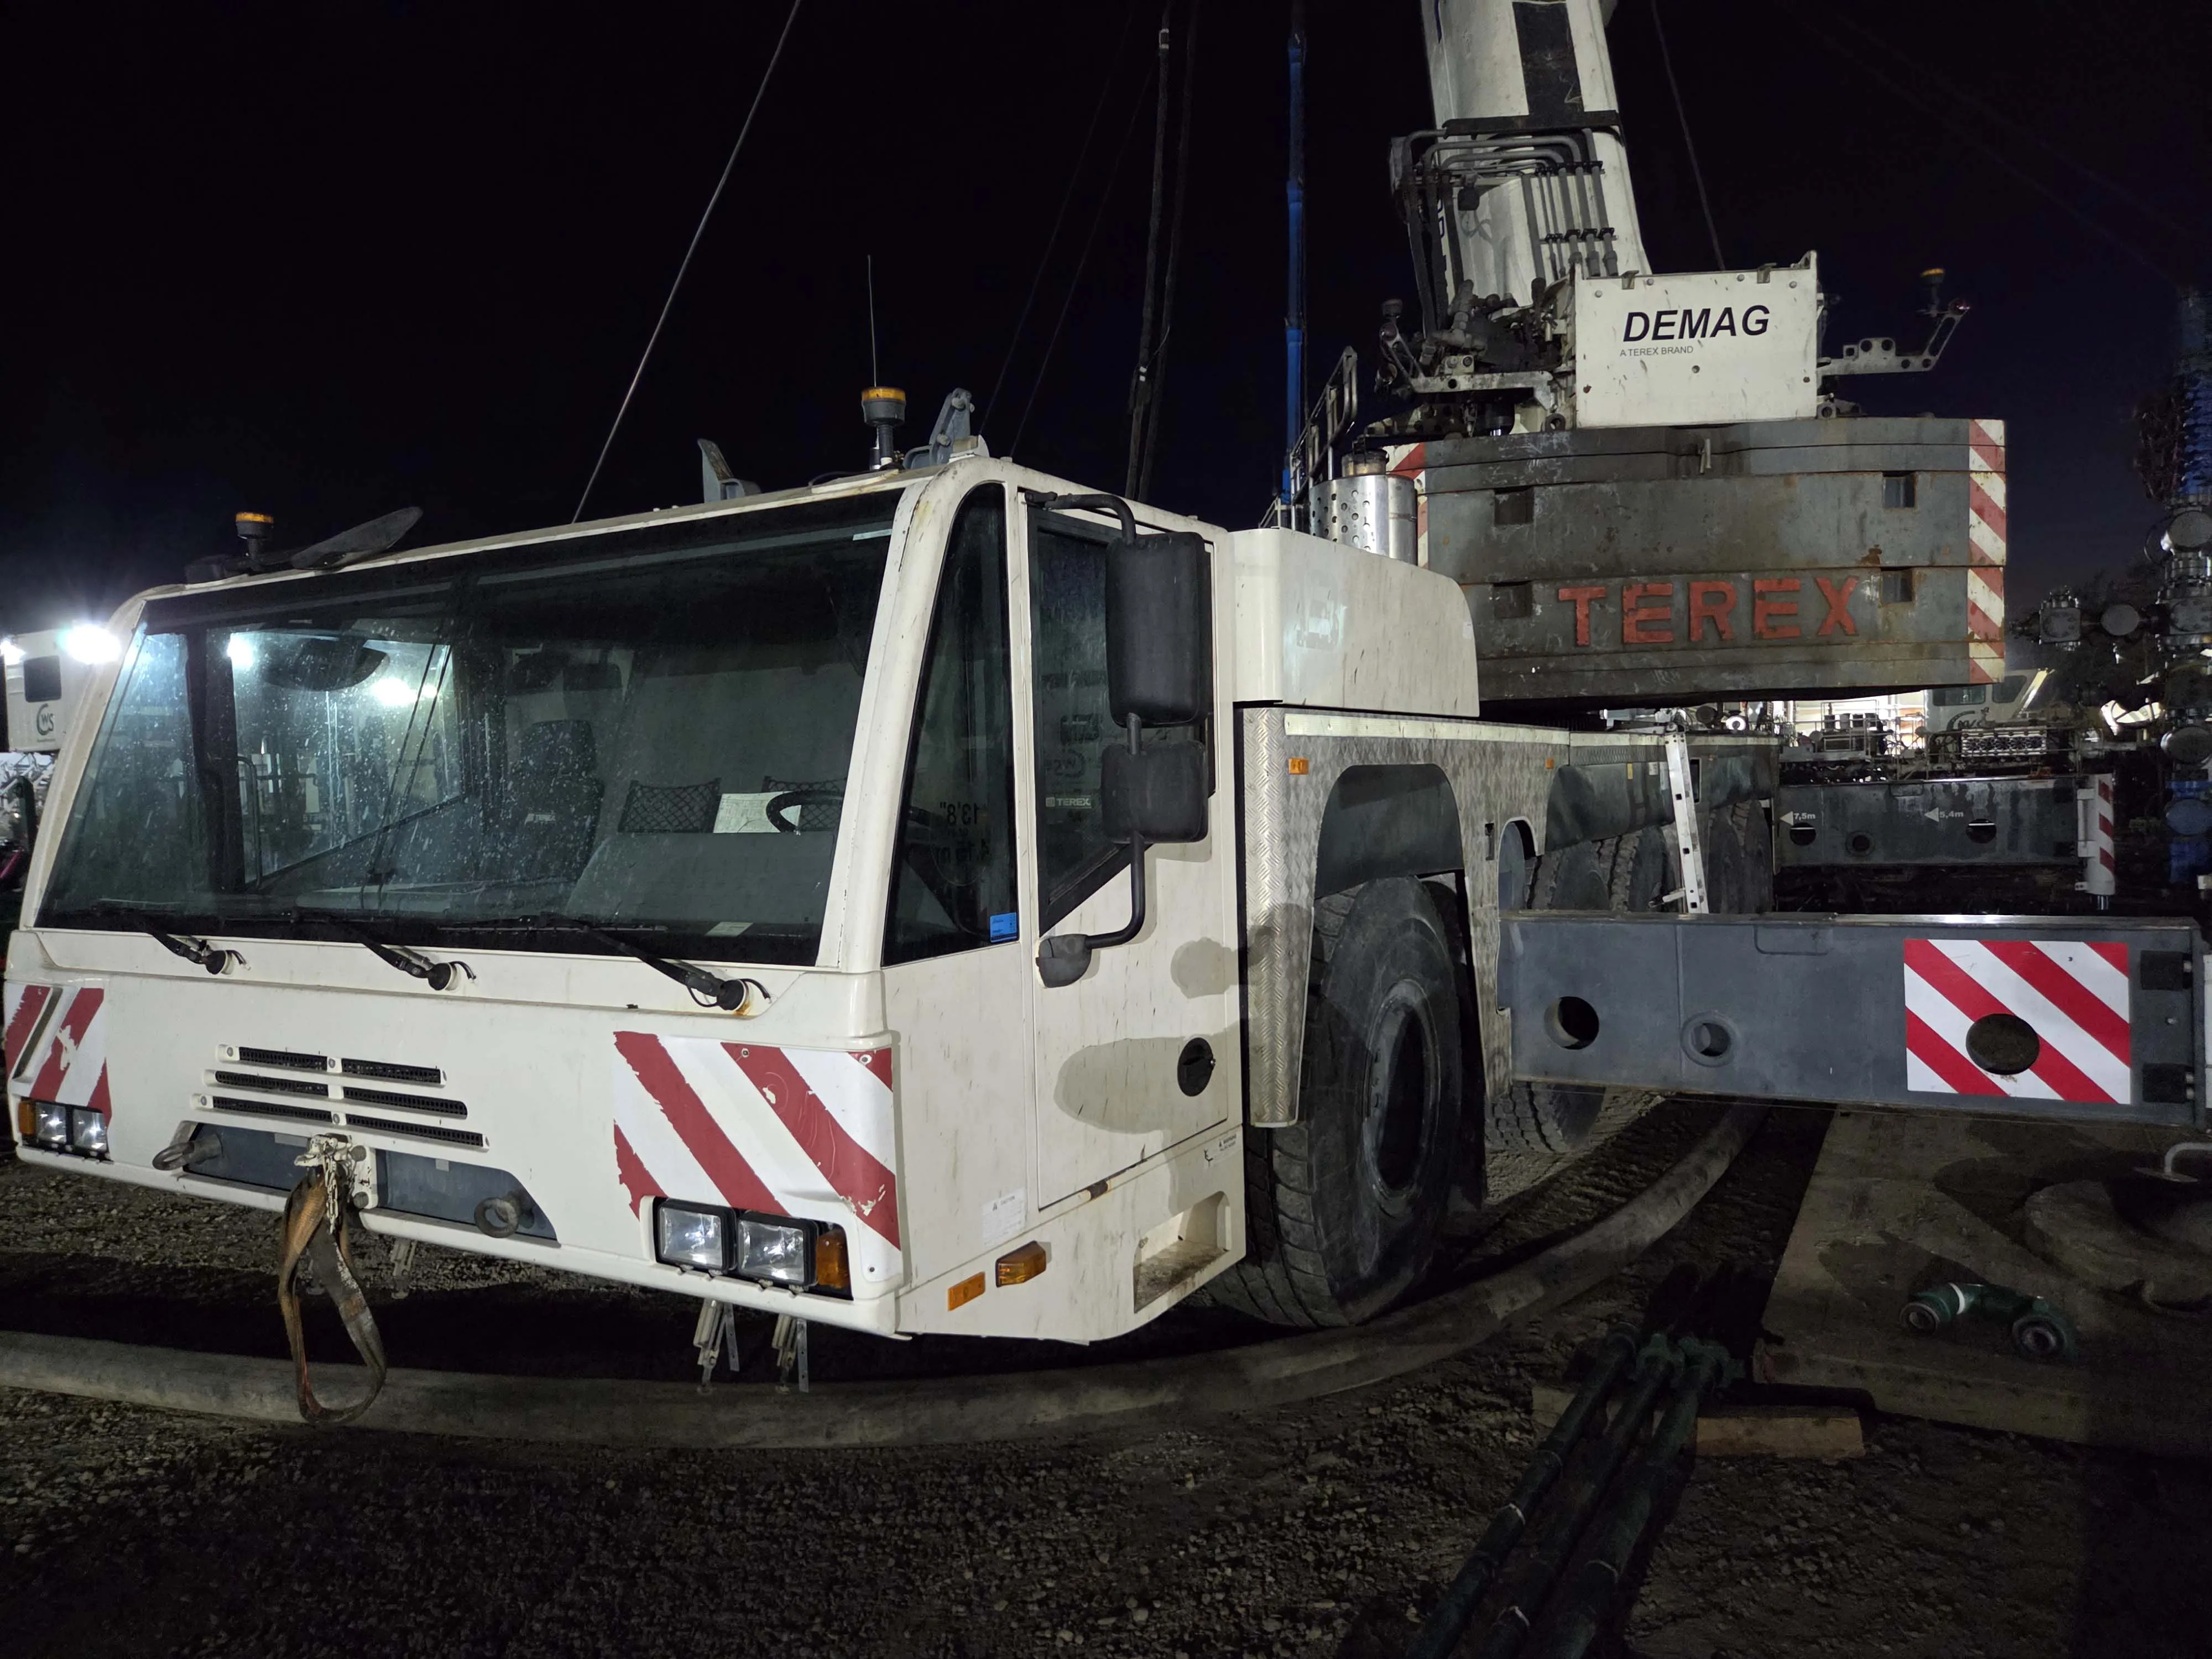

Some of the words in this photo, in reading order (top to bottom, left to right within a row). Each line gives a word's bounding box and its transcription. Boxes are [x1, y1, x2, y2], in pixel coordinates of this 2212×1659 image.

[1624, 305, 1770, 342] DEMAG
[1628, 347, 1658, 356] TEREX
[1661, 346, 1693, 354] BRAND
[1558, 577, 1859, 646] TEREX
[1056, 797, 1092, 806] TEREX
[1793, 812, 1816, 821] 7,5m
[1939, 810, 1964, 819] 5,4m
